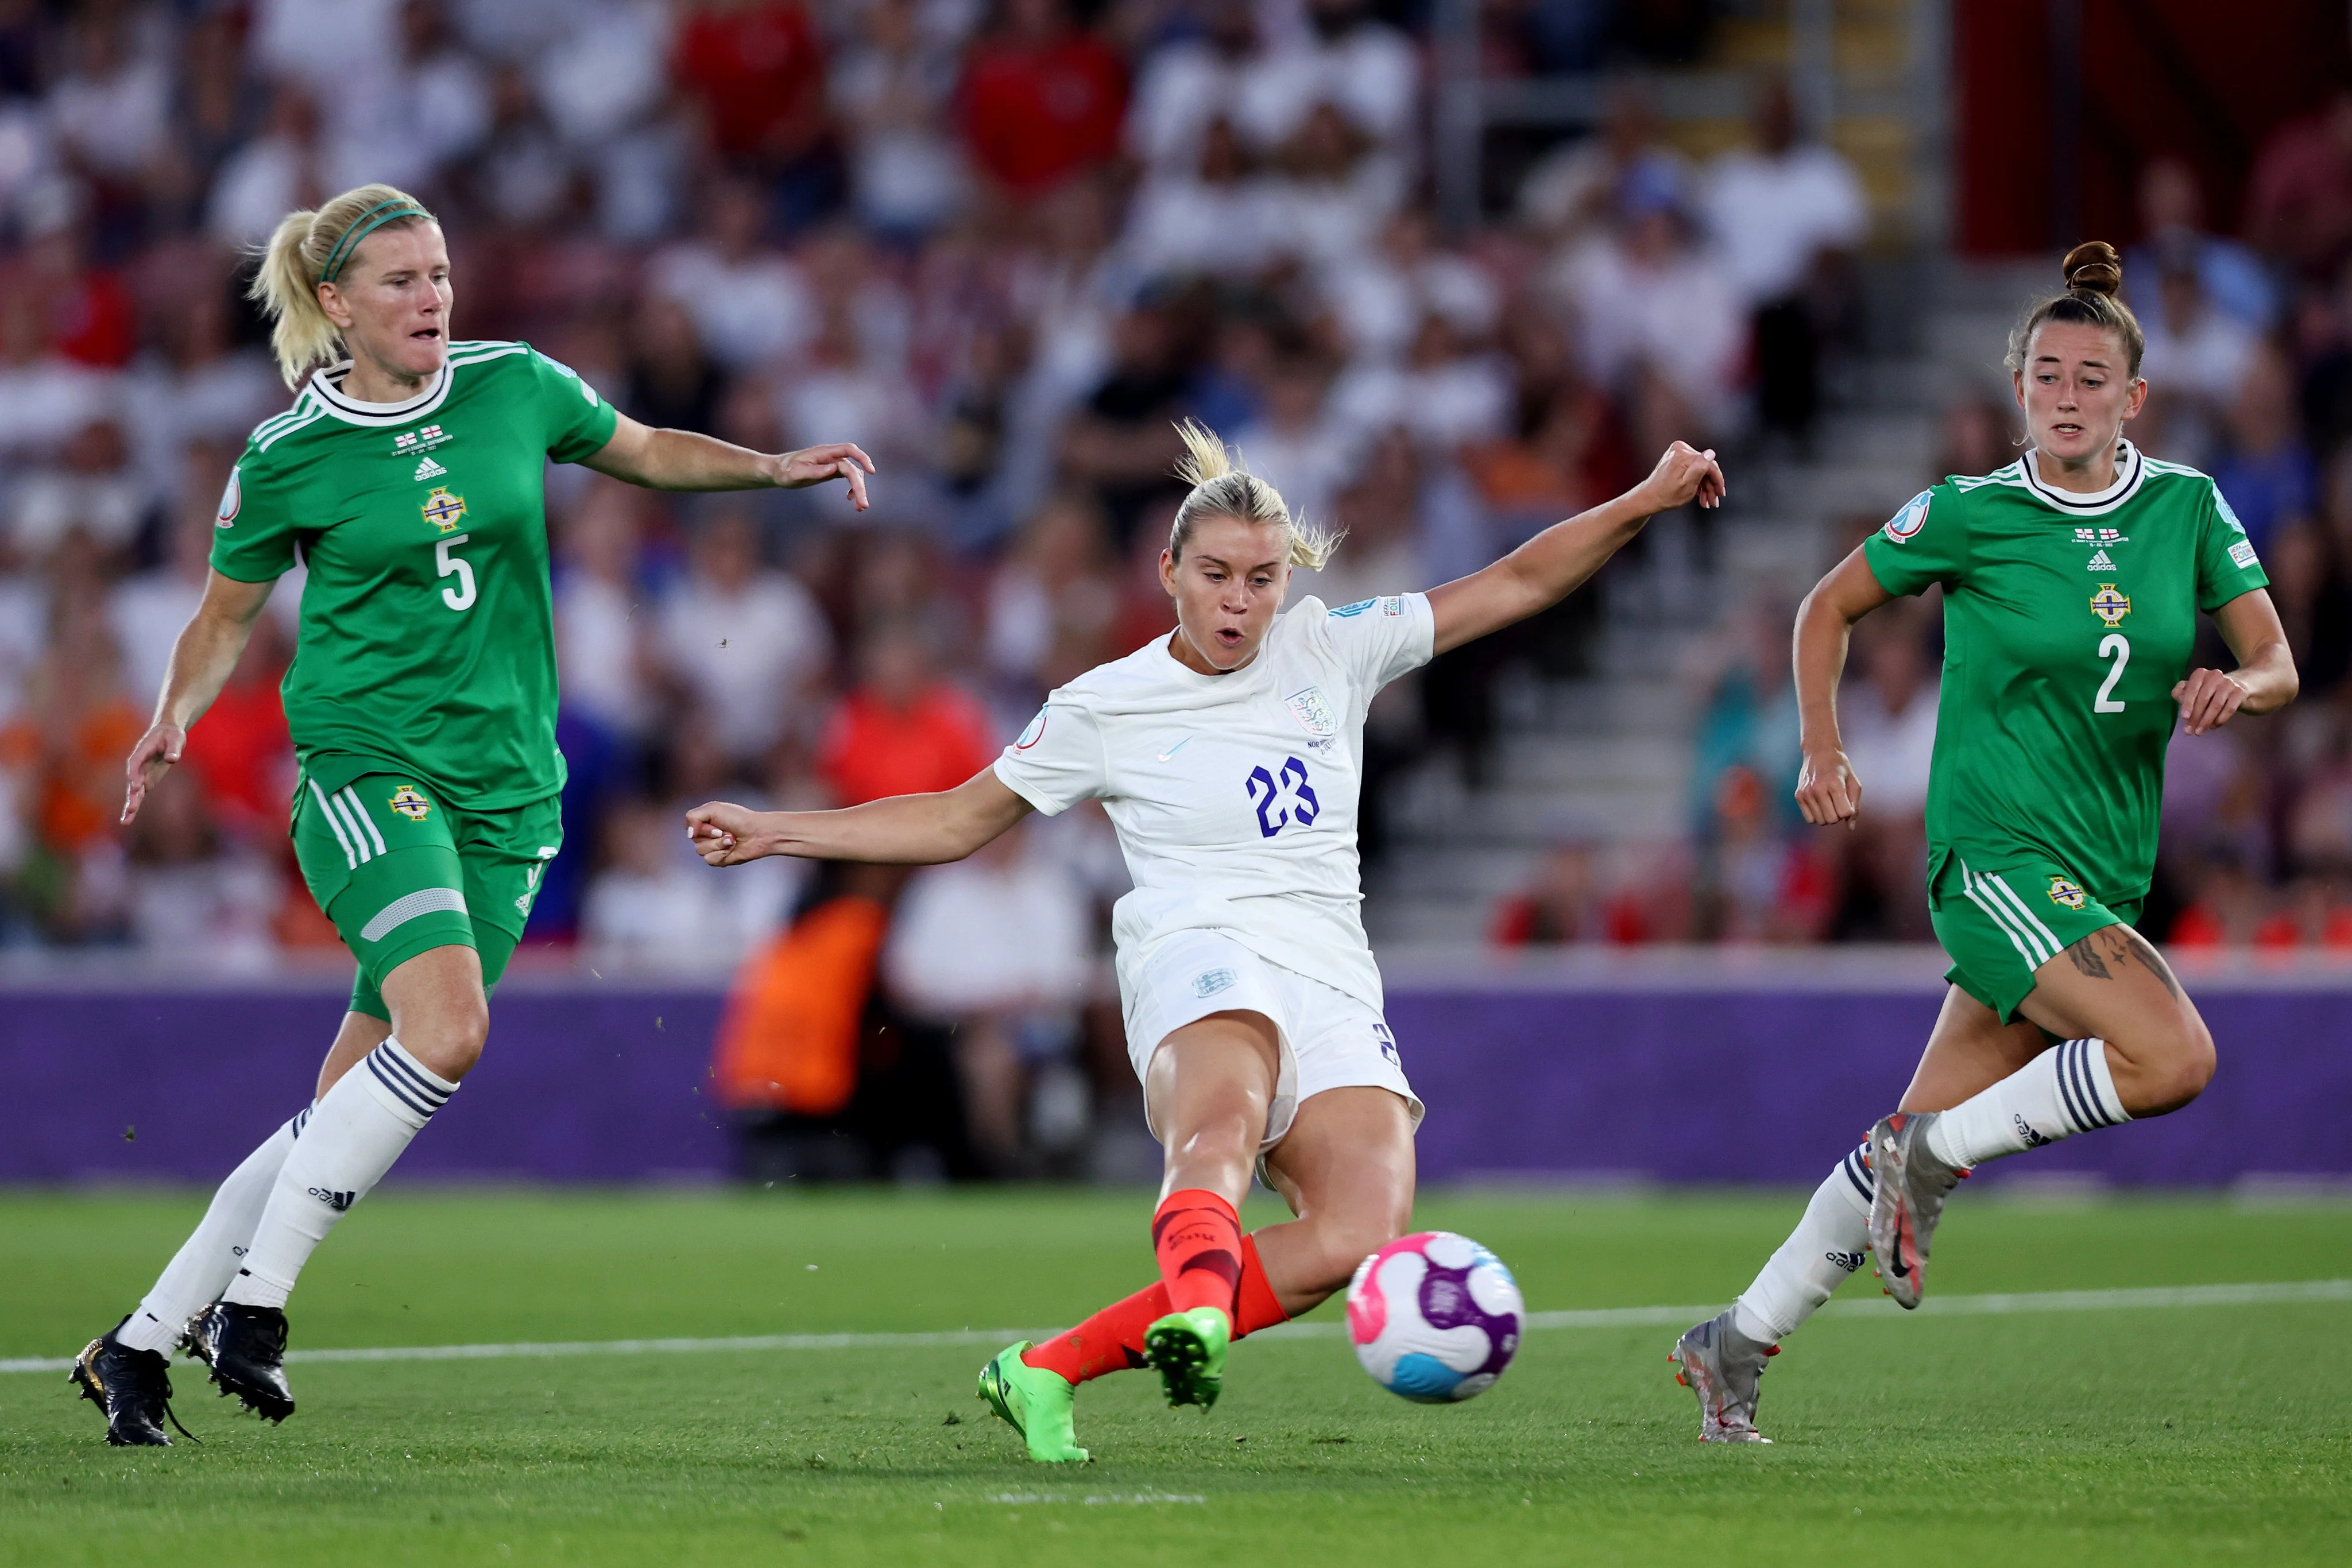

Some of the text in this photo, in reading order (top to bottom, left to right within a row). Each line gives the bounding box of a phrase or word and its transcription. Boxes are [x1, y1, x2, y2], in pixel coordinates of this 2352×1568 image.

[415, 466, 447, 482] adidas
[436, 534, 477, 611] 5
[2087, 563, 2117, 571] adidas
[2094, 633, 2130, 713] 2
[1245, 756, 1320, 838] 23
